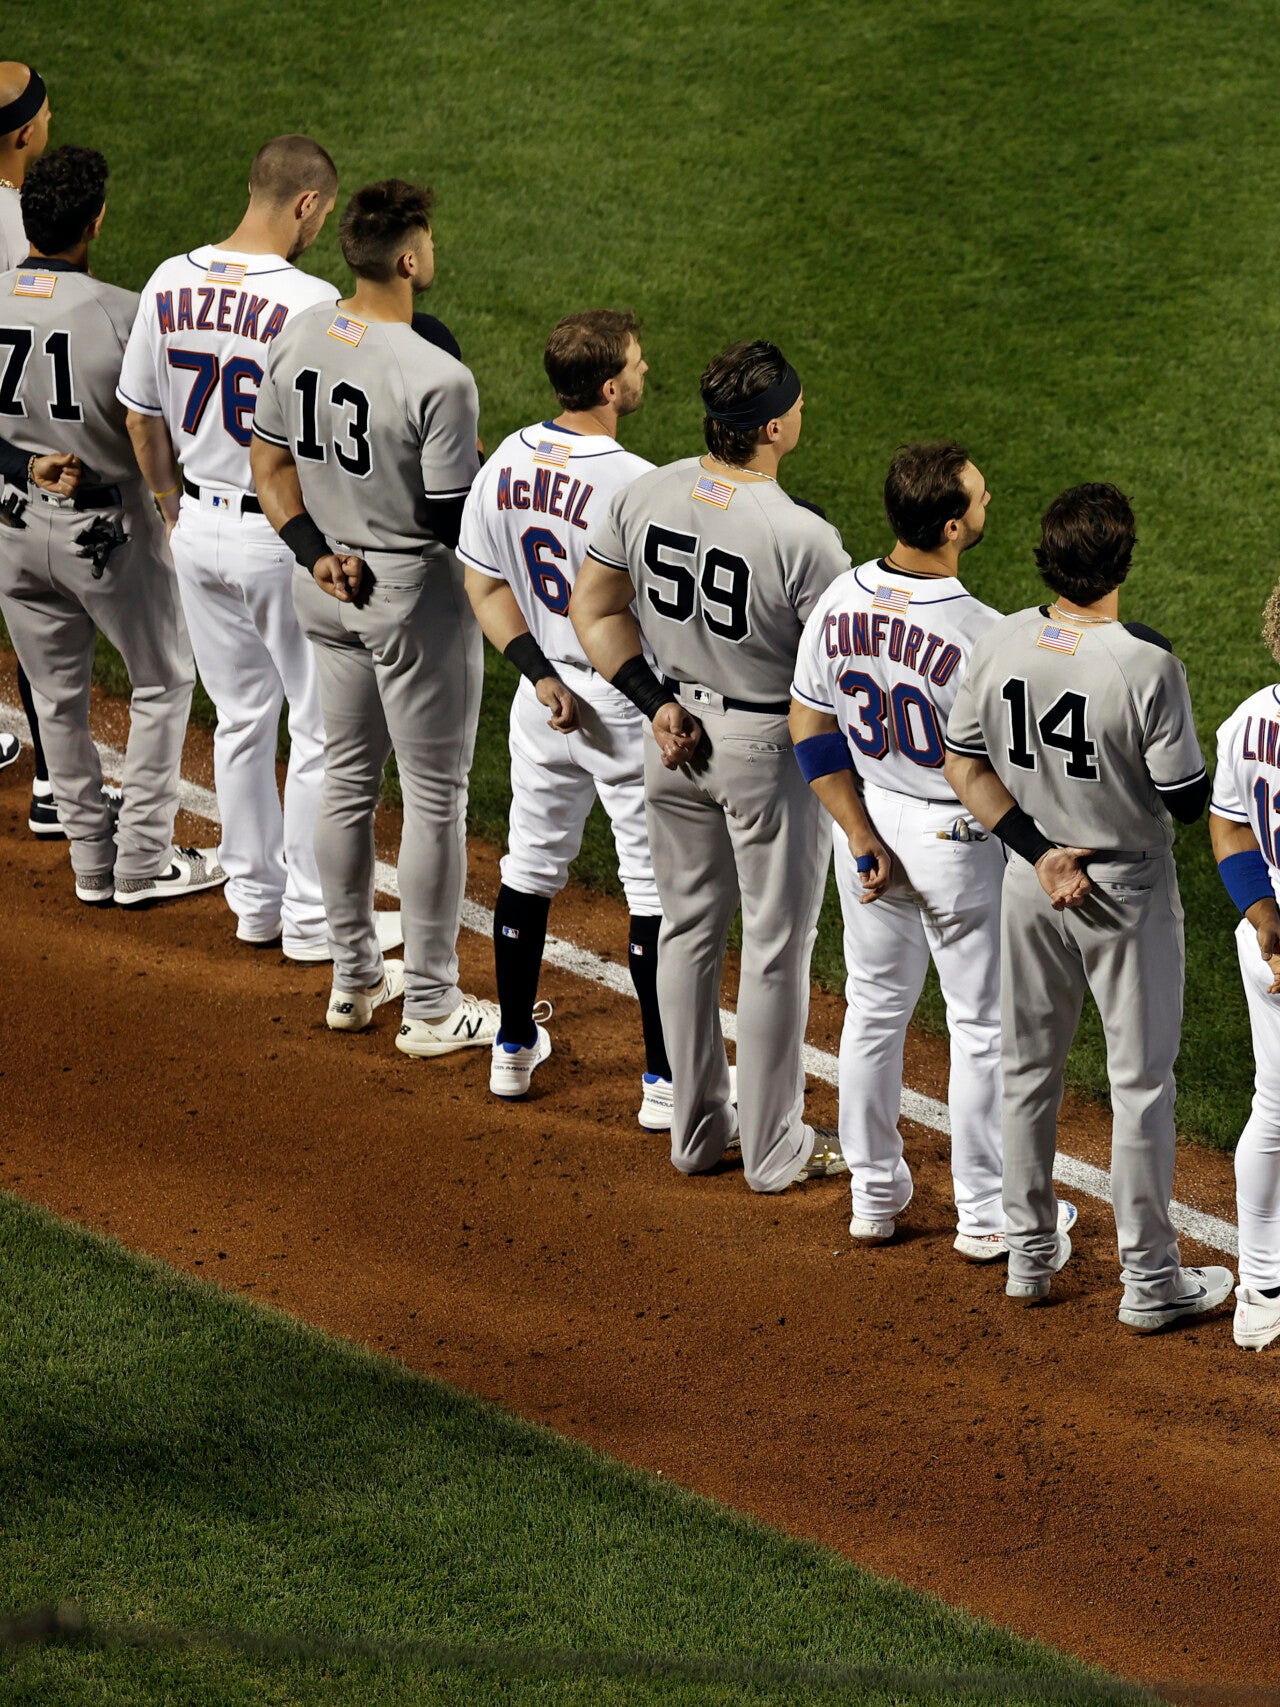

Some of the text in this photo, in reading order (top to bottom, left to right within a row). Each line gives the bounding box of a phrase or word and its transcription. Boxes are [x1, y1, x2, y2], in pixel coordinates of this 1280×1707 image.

[156, 288, 289, 344] MAZEIKA
[0, 325, 84, 422] 71
[167, 348, 265, 447] 76
[292, 366, 374, 479] 13
[497, 466, 593, 530] McNEIL
[520, 526, 571, 617] 6
[642, 520, 753, 643] 59
[825, 612, 961, 686] CONFORTO
[838, 669, 945, 768] 30
[1000, 675, 1101, 781] 14
